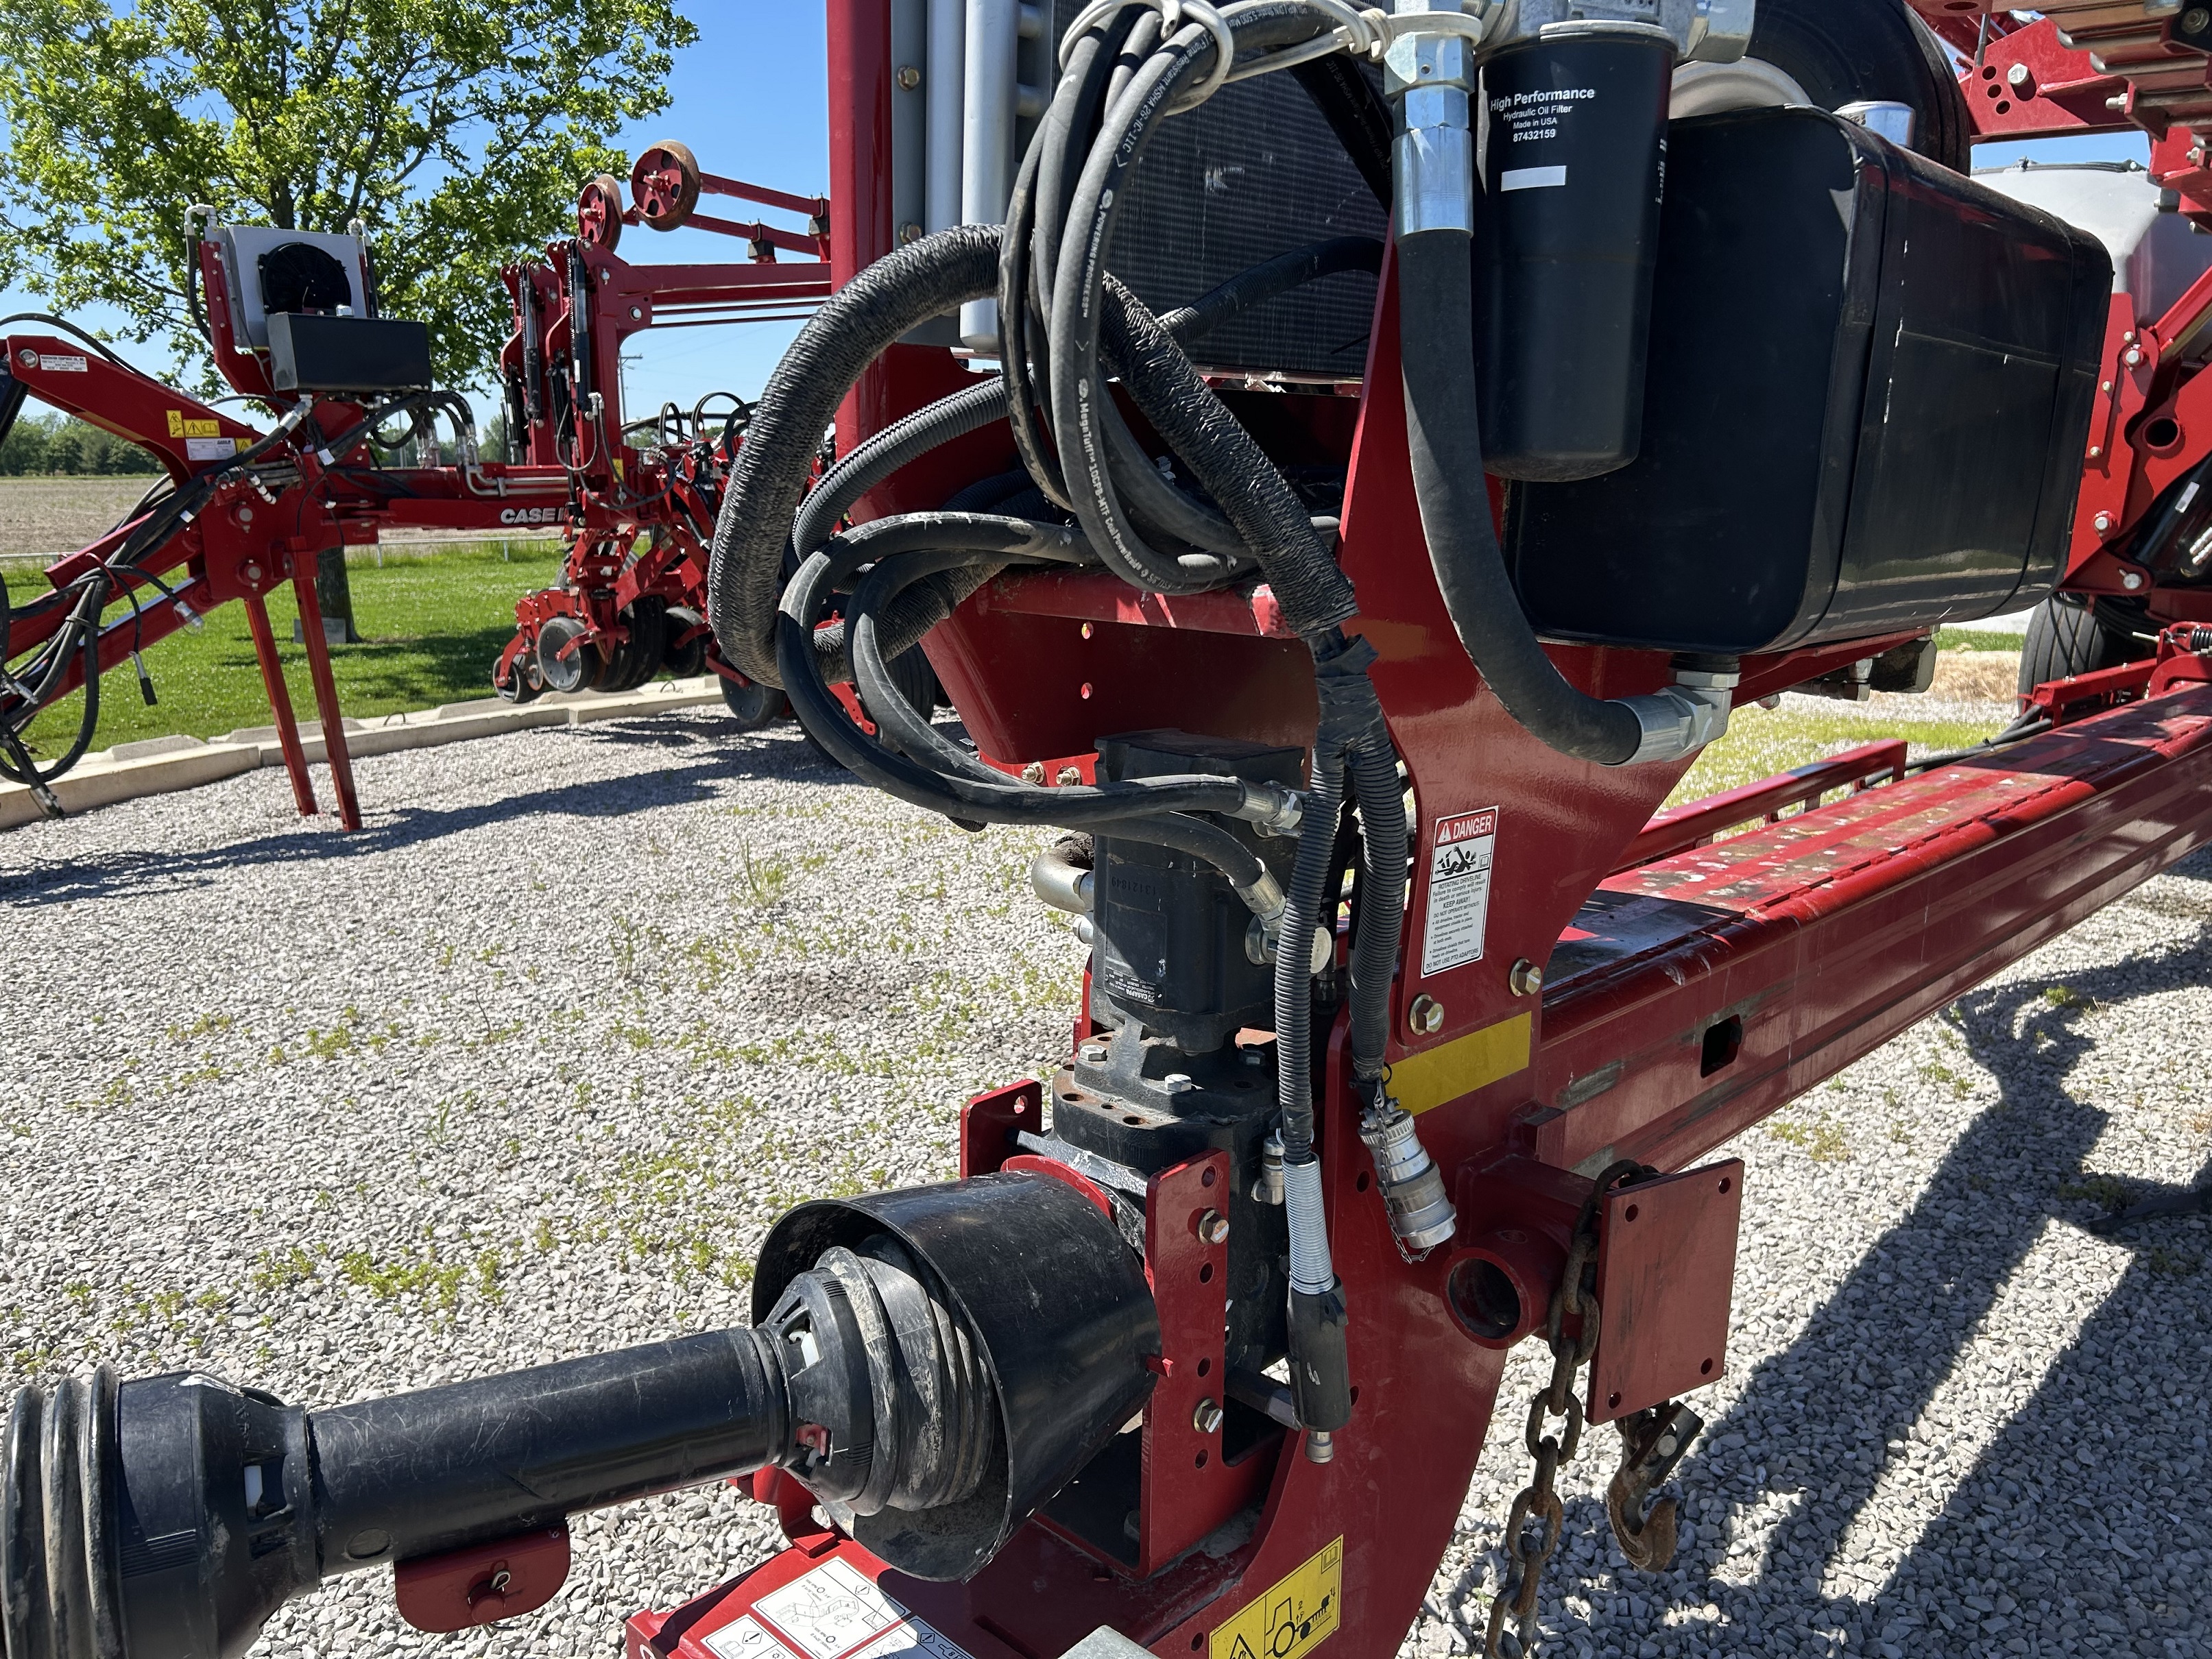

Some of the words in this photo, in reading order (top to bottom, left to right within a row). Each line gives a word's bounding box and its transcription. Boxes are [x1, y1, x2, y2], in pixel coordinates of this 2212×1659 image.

[1186, 36, 1205, 57] Flame
[1162, 53, 1190, 86] Resistant
[1147, 82, 1164, 106] MSHA
[1490, 97, 1511, 112] High
[1513, 88, 1596, 106] Performance
[1503, 108, 1536, 122] Hydraulic
[1538, 106, 1549, 115] Oil
[1551, 104, 1573, 114] Filter
[1513, 120, 1531, 130] Made
[1541, 117, 1557, 125] USA
[1513, 128, 1556, 143] 87432159
[1089, 210, 1107, 259] POWERING
[501, 507, 556, 524] CASE
[1453, 815, 1492, 840] DANGER
[1439, 880, 1459, 889] ROTATING
[1460, 873, 1481, 884] DRIVELINE
[1452, 884, 1466, 893] comply
[1443, 900, 1455, 909] KEEP
[1456, 896, 1470, 905] AWAY!
[1459, 947, 1478, 958] ADAPTORS
[1126, 989, 1148, 1000] CASAPPA
[1298, 1601, 1303, 1610] 2
